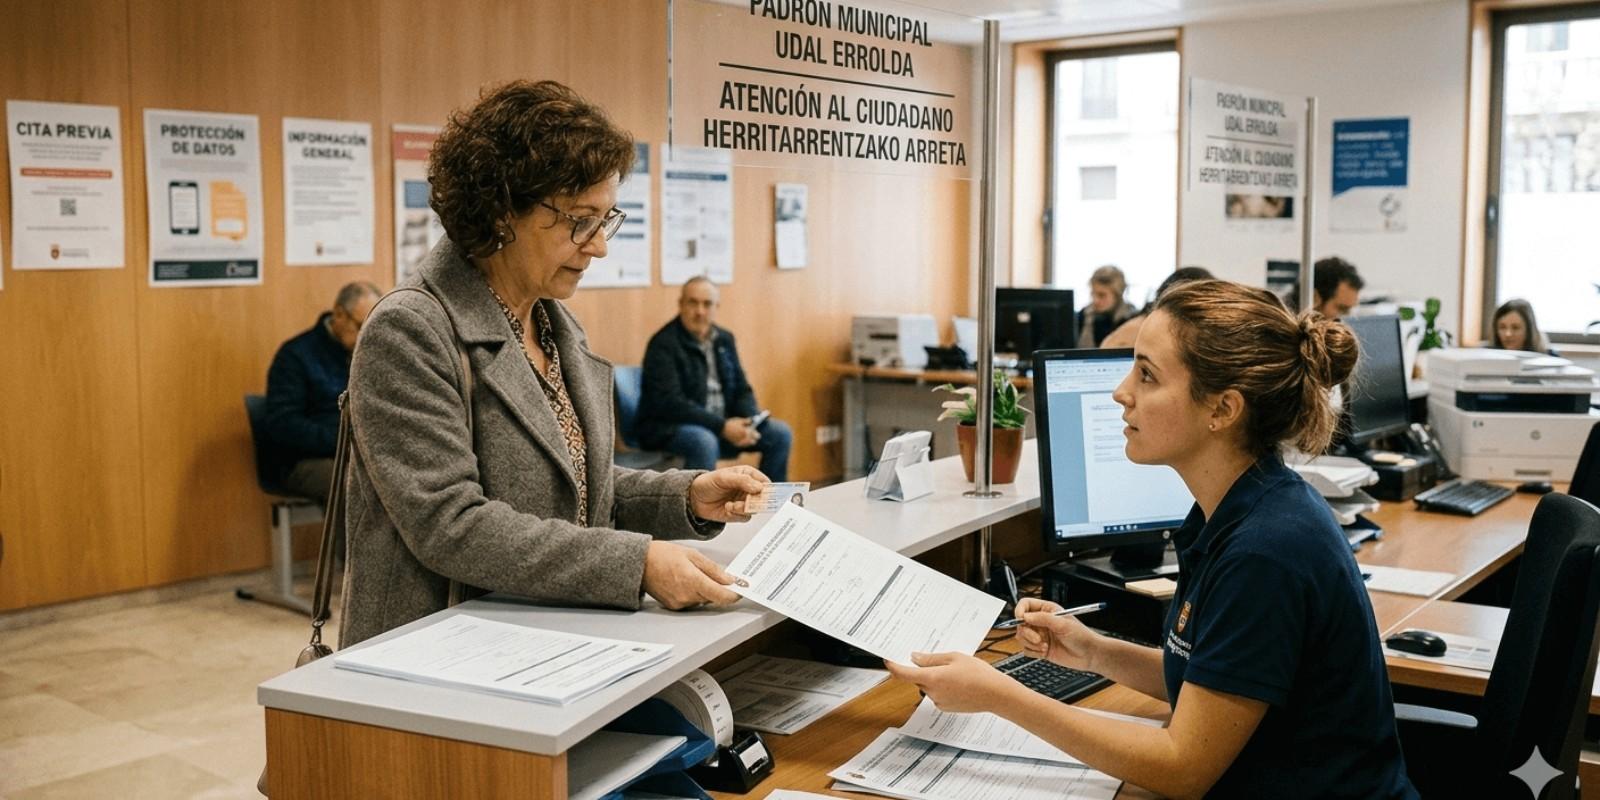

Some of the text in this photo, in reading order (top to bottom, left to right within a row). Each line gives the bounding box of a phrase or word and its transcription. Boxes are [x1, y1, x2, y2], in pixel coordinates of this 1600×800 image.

[838, 4, 933, 47] MUNICIPAL
[775, 30, 914, 78] UDAL ERROLDA
[719, 80, 954, 133] ATENCIÓN AL CIUDADANO
[16, 122, 113, 140] CITA PREVIA
[160, 123, 246, 141] PROTECCIÓN
[288, 131, 367, 146] INFORMACIÓN
[172, 141, 236, 157] DE DATOS
[703, 118, 966, 166] HERRITARRENTZAKO ARRETA
[302, 147, 354, 161] GENERAL
